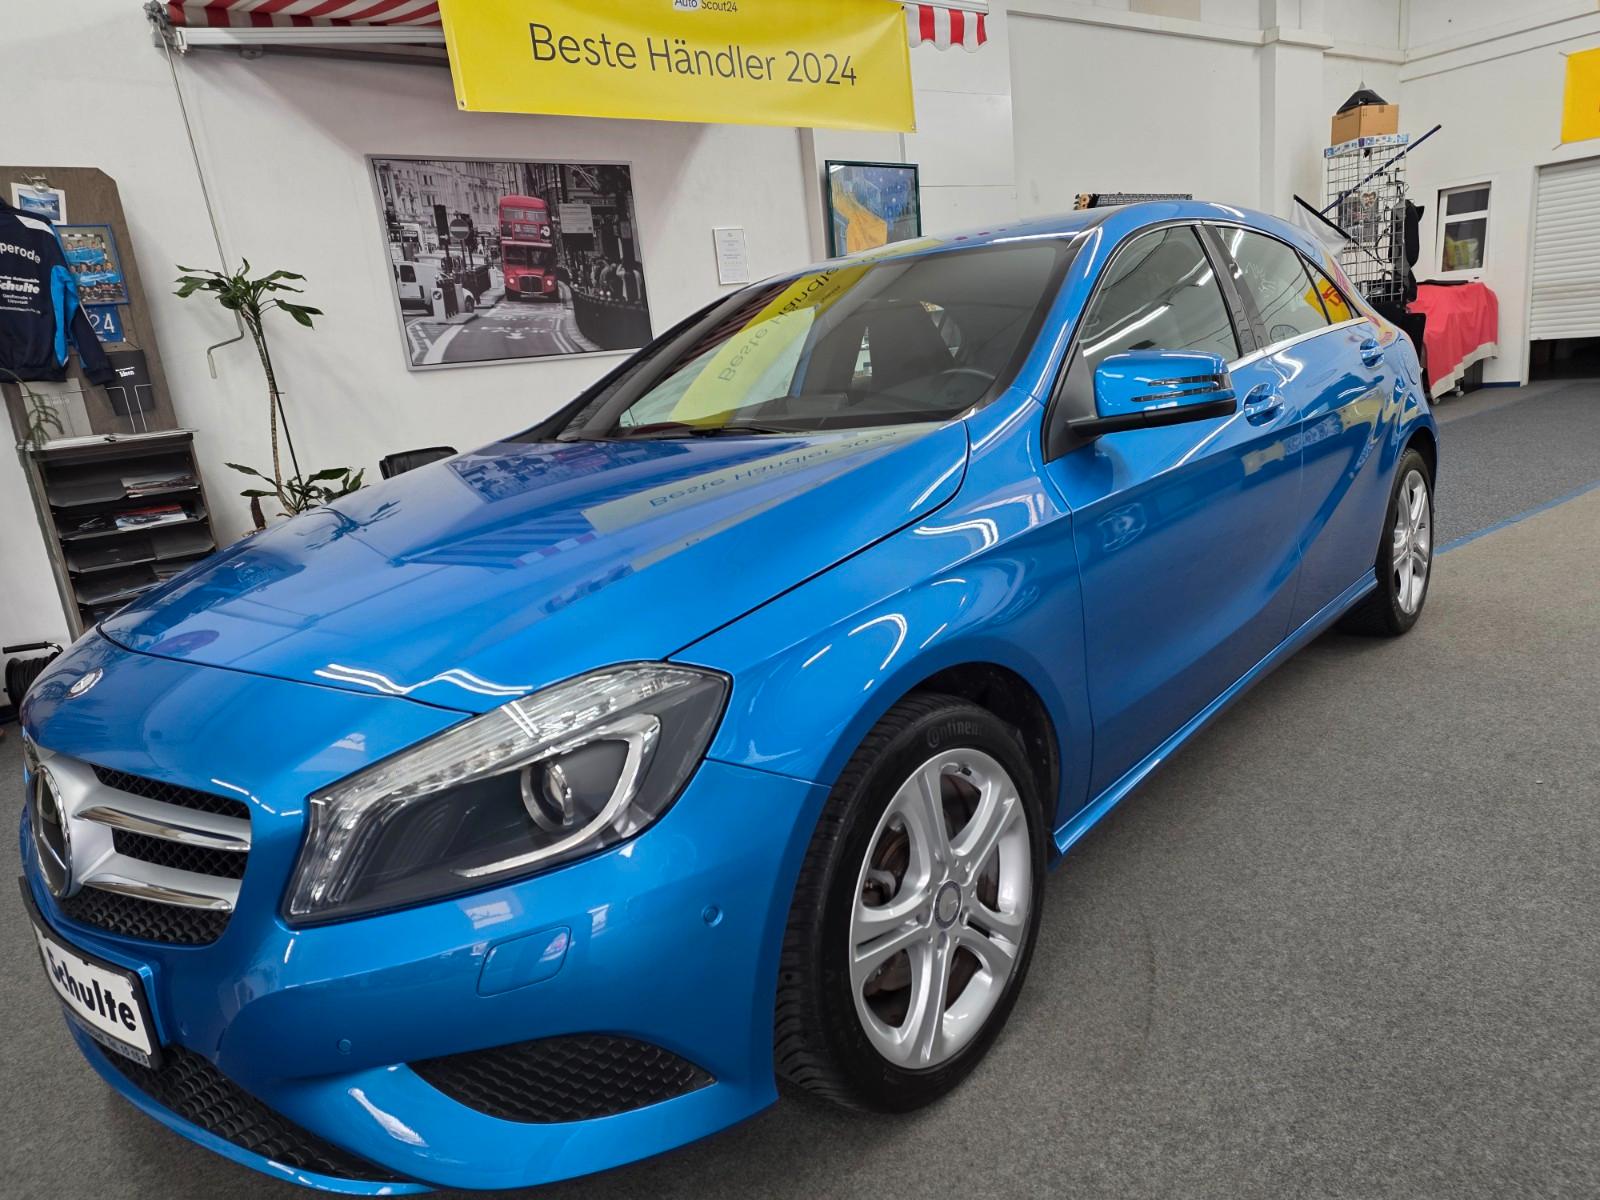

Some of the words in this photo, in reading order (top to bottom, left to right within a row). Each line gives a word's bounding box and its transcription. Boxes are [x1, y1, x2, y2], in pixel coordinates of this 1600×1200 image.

[701, 0, 738, 13] Scout24
[529, 22, 637, 70] Beste
[646, 36, 776, 81] Händler
[785, 50, 857, 86] 2024
[0, 280, 40, 294] chulte
[46, 946, 137, 1032] Schulte
